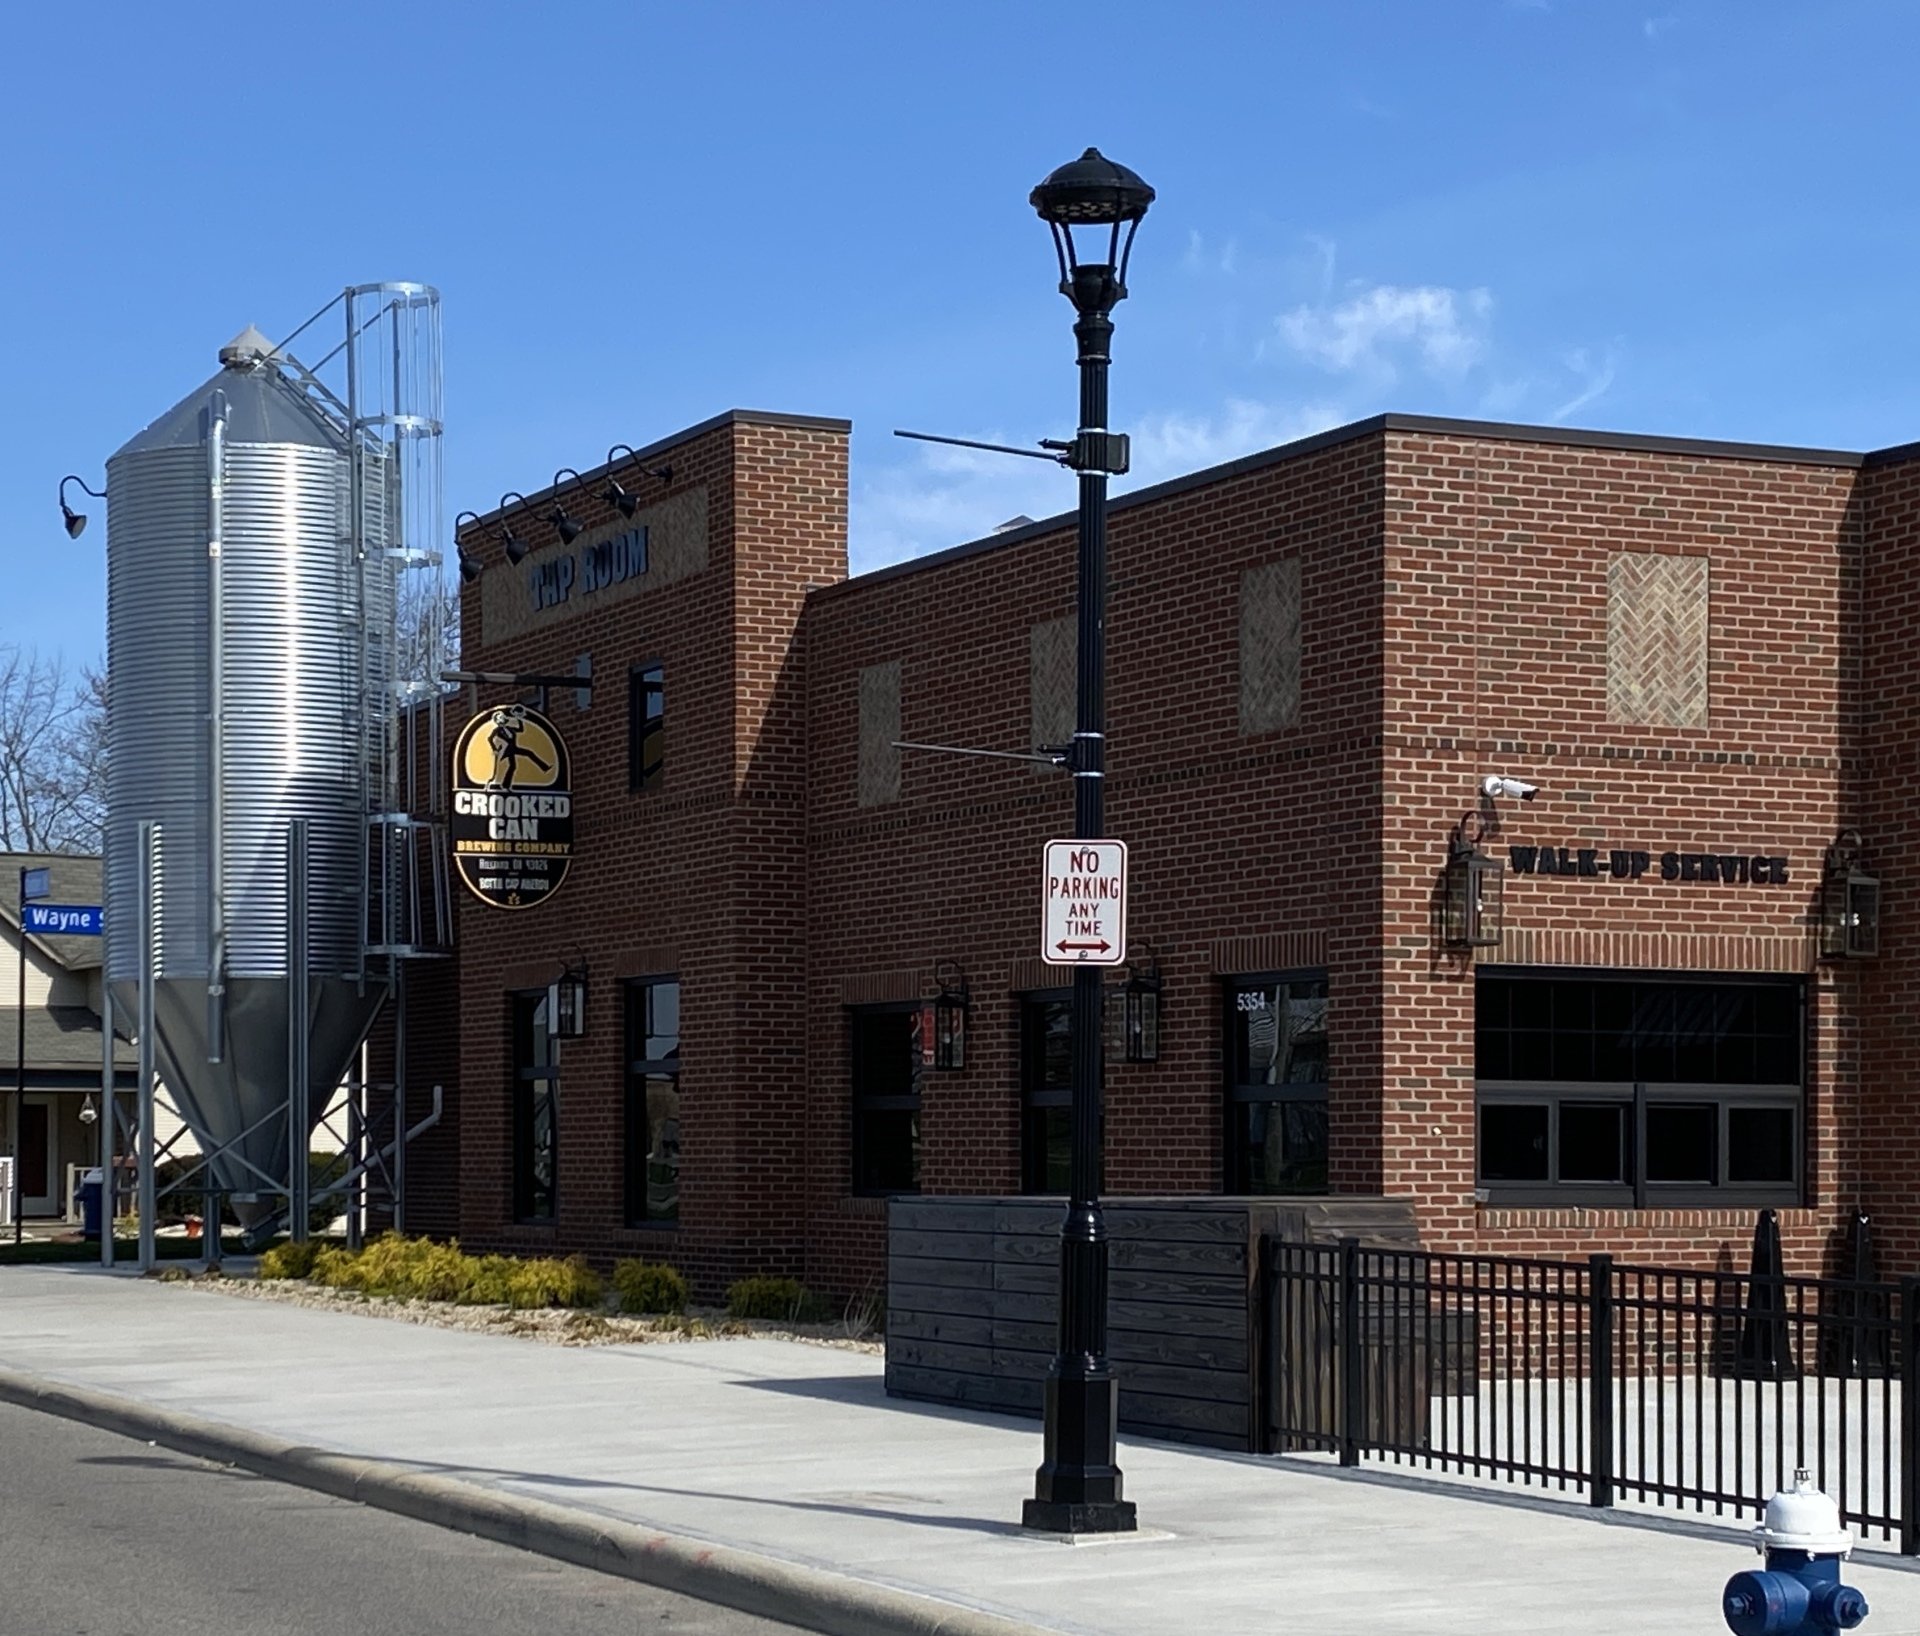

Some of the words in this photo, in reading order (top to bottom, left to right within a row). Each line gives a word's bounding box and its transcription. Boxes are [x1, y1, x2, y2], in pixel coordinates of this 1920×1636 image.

[529, 554, 576, 612] TAP
[582, 525, 649, 595] ROOM
[454, 791, 570, 818] CROOKED
[488, 818, 539, 840] CAN
[457, 840, 512, 852] BREWING
[515, 841, 570, 854] COMPANY
[1070, 851, 1099, 873] NO
[1509, 845, 1651, 879] WALK-UP
[1660, 852, 1790, 884] SERVICE
[1050, 877, 1119, 899] PARKING
[32, 908, 91, 931] Wayne
[1068, 903, 1100, 918] ANY
[1065, 921, 1102, 936] TIME
[1237, 991, 1265, 1011] 5354
